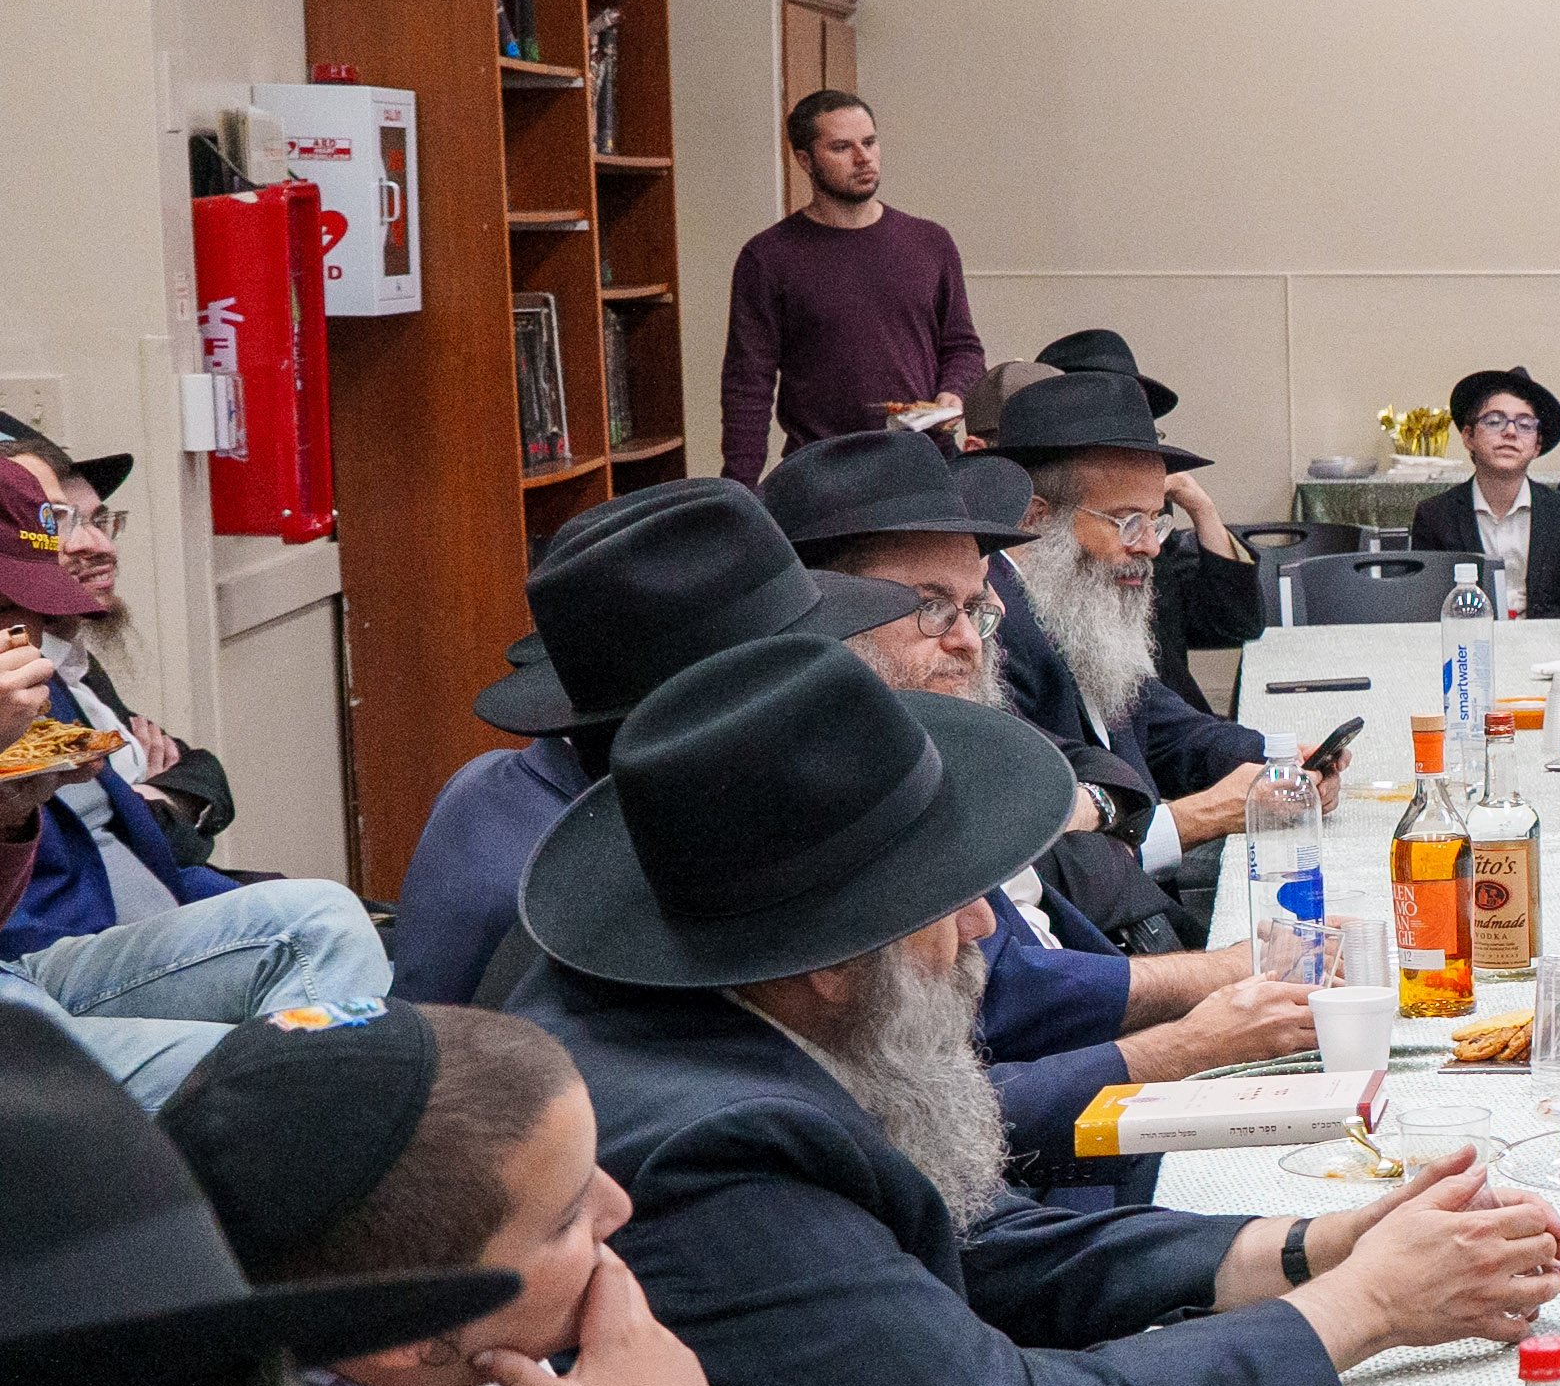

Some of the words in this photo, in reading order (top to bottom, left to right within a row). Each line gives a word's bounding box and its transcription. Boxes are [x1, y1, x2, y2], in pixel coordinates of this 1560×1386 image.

[1456, 644, 1470, 721] smartwater
[1393, 884, 1415, 902] LEN
[1403, 950, 1412, 962] 12
